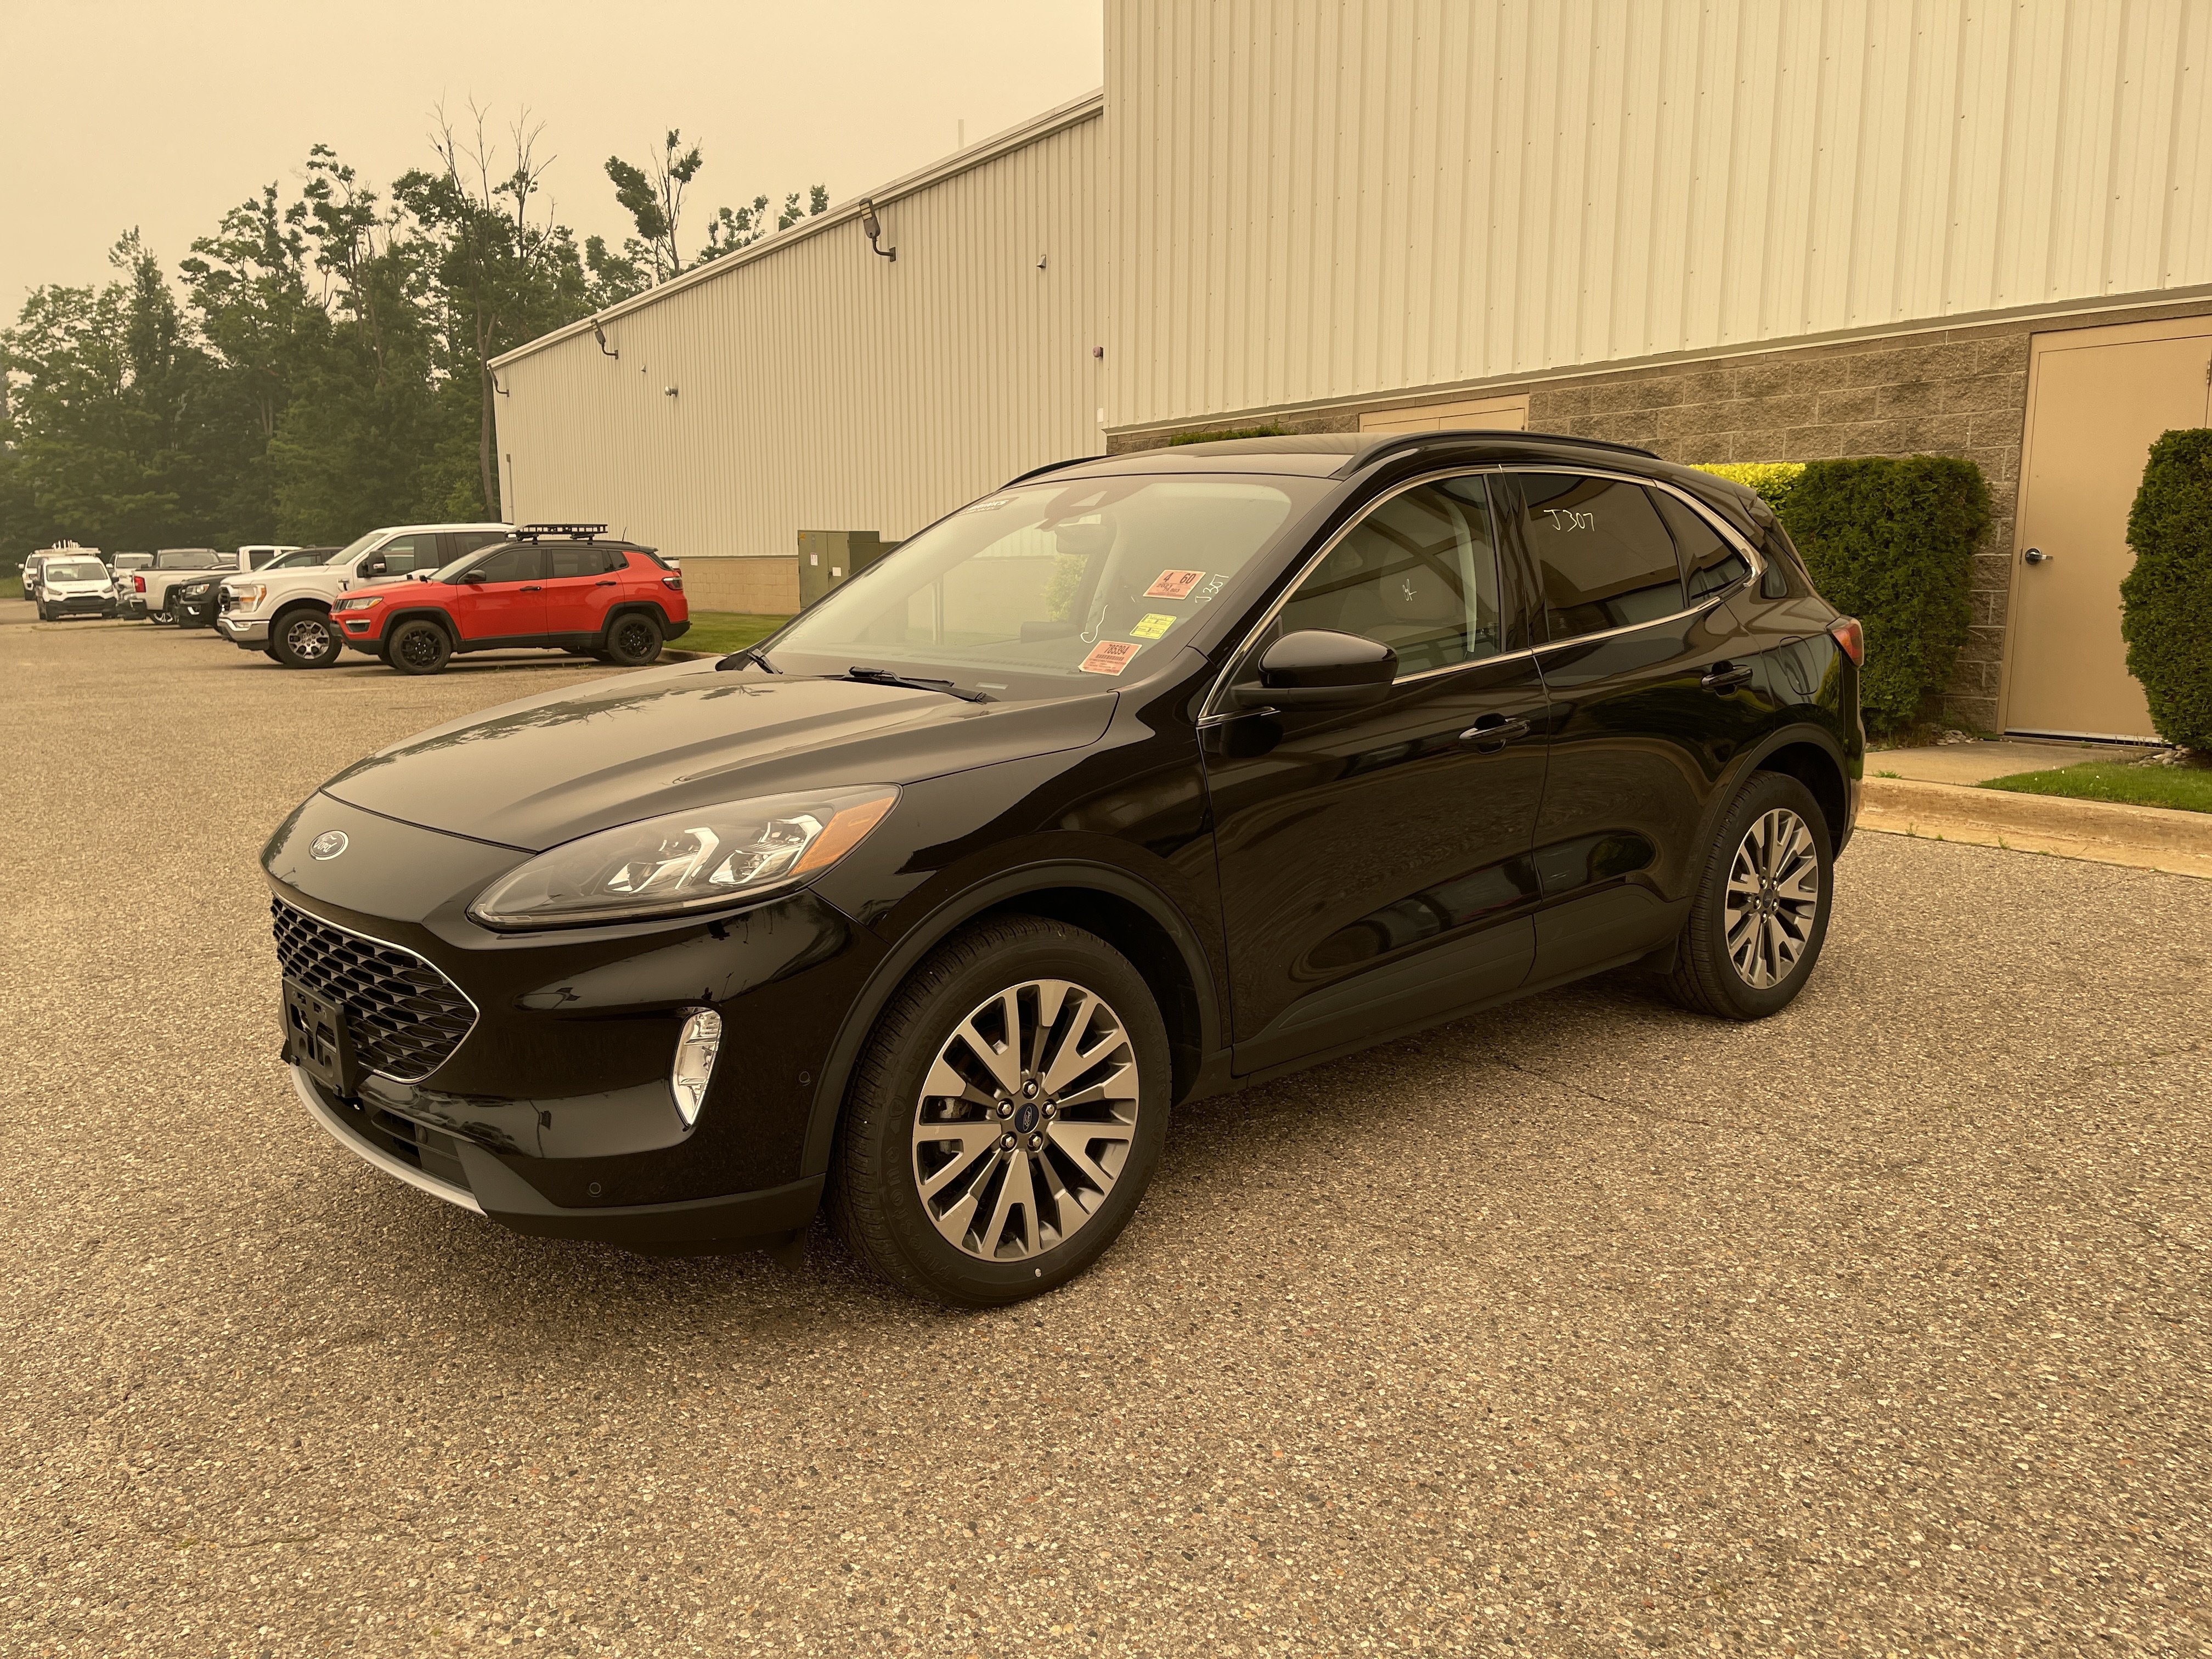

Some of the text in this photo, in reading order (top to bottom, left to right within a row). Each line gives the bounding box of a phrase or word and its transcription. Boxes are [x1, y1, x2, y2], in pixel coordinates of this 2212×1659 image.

[1163, 572, 1197, 584] 4 60
[1104, 644, 1130, 655] 785394
[885, 1146, 953, 1281] Firestone
